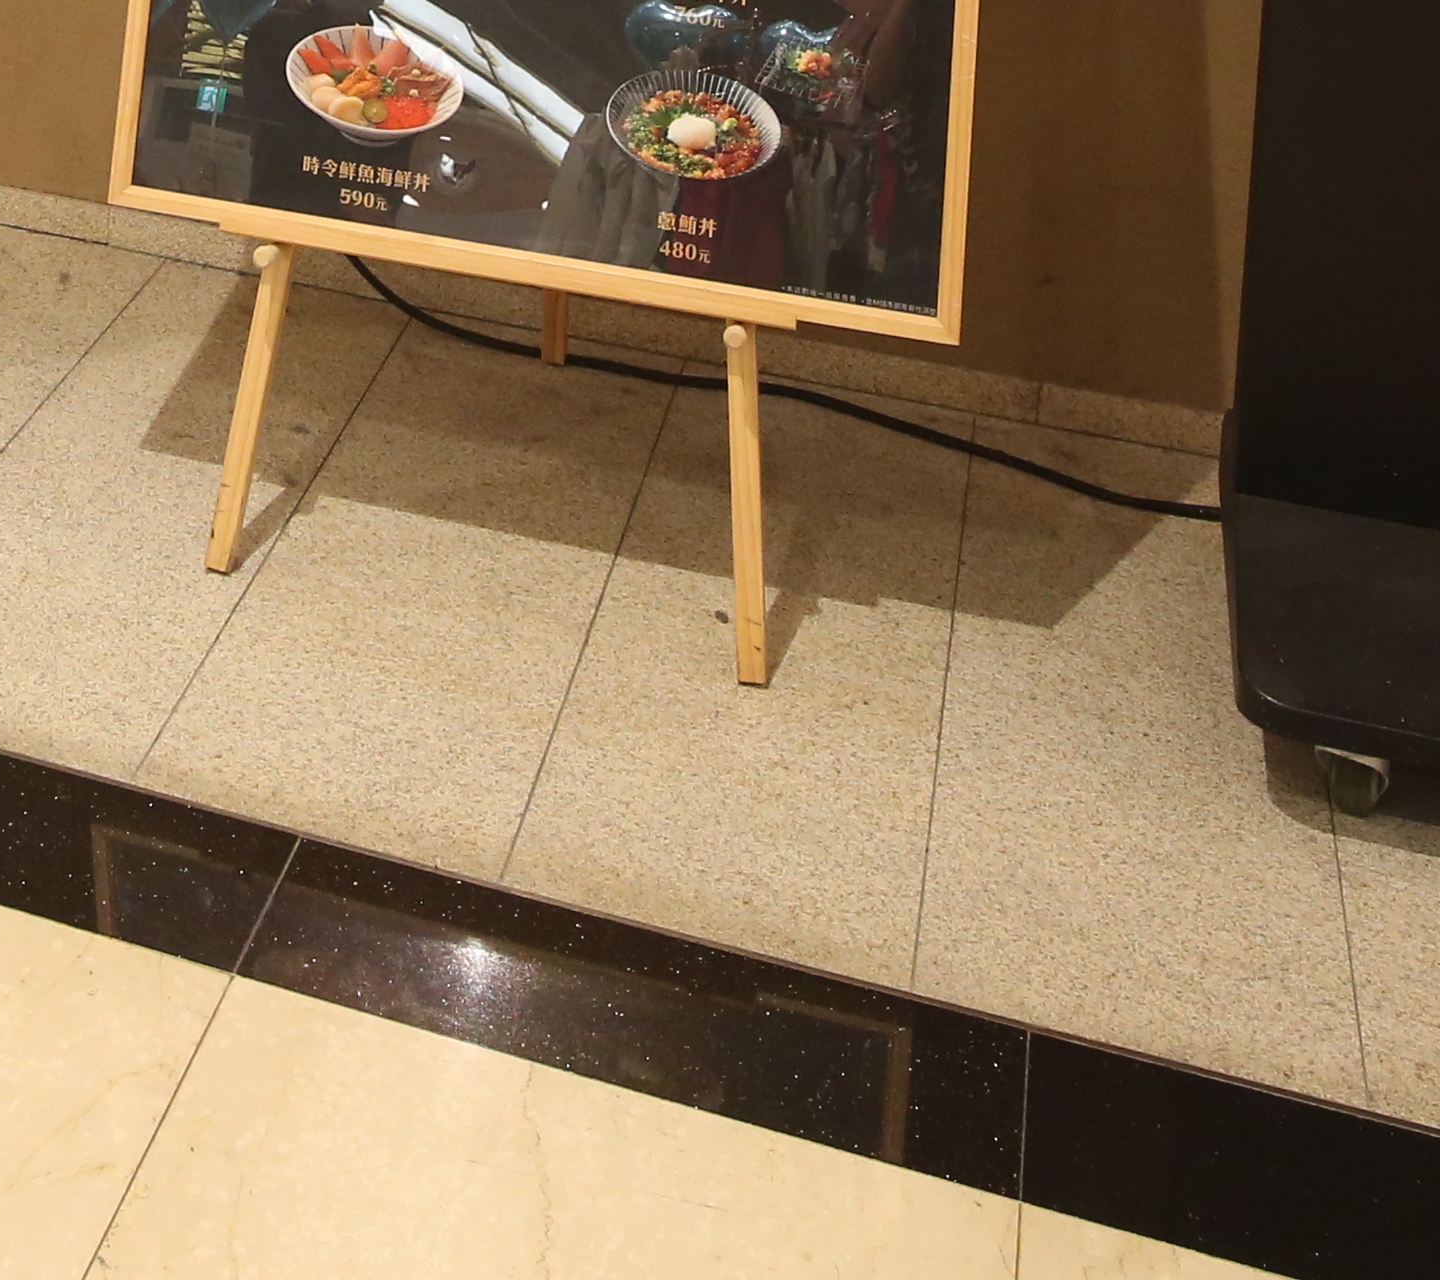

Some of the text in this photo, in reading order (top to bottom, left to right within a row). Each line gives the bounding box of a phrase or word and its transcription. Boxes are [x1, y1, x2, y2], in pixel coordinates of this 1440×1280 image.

[302, 155, 431, 193] 時令鮮魚海鮮丼
[339, 187, 389, 211] 590元
[659, 240, 712, 264] 480元
